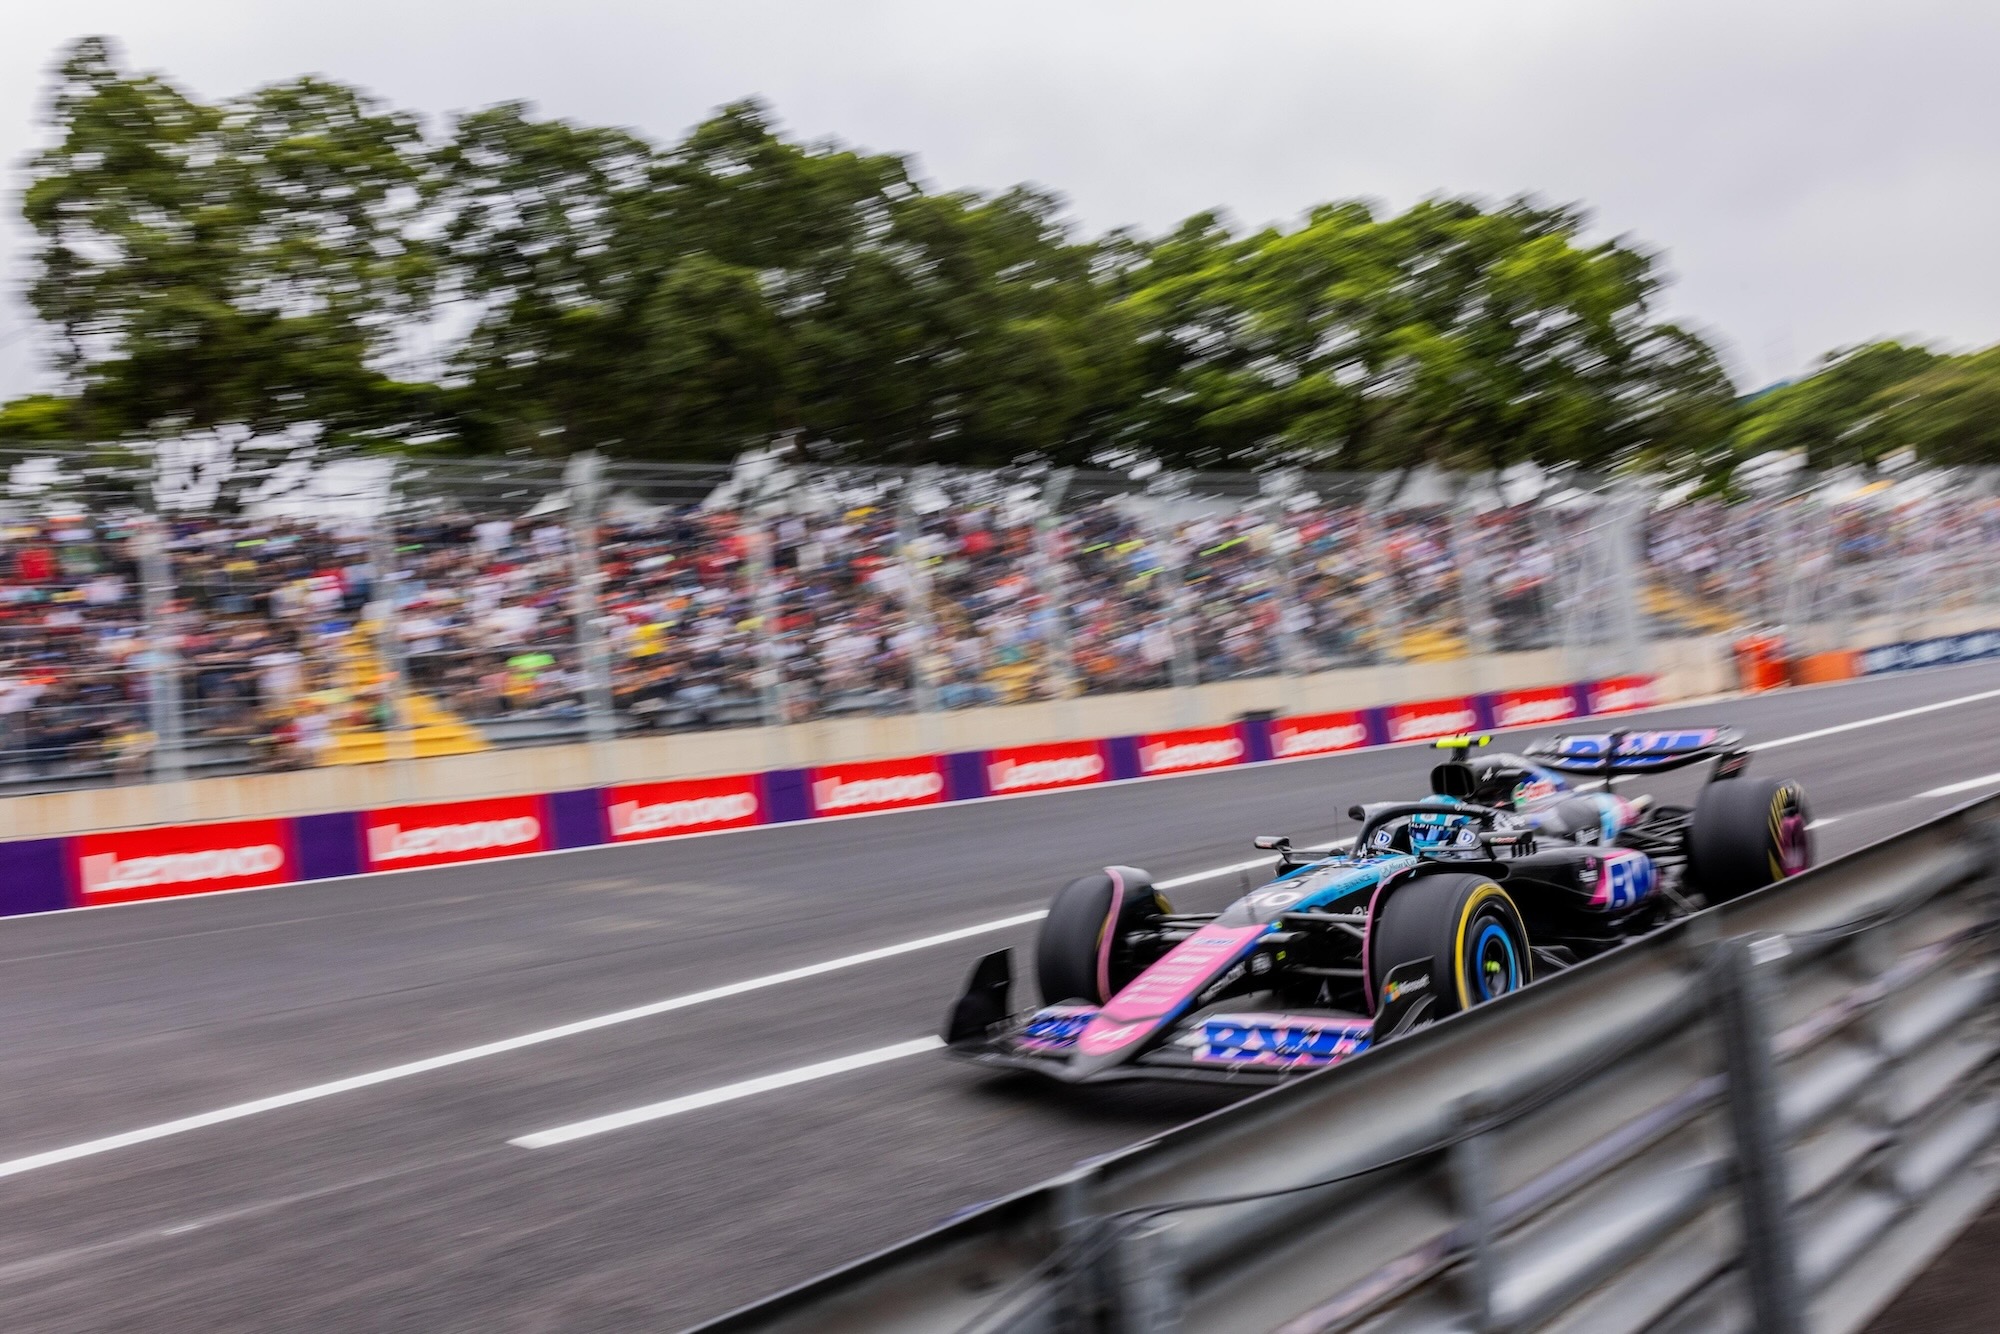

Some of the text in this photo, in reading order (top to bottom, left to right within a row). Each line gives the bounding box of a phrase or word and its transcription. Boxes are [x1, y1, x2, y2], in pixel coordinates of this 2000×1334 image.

[812, 772, 944, 811] Lenovo
[987, 754, 1104, 791] Lenovo
[607, 792, 758, 836] Lenovo
[367, 816, 540, 862] Lenovo
[80, 843, 285, 893] Lenovo
